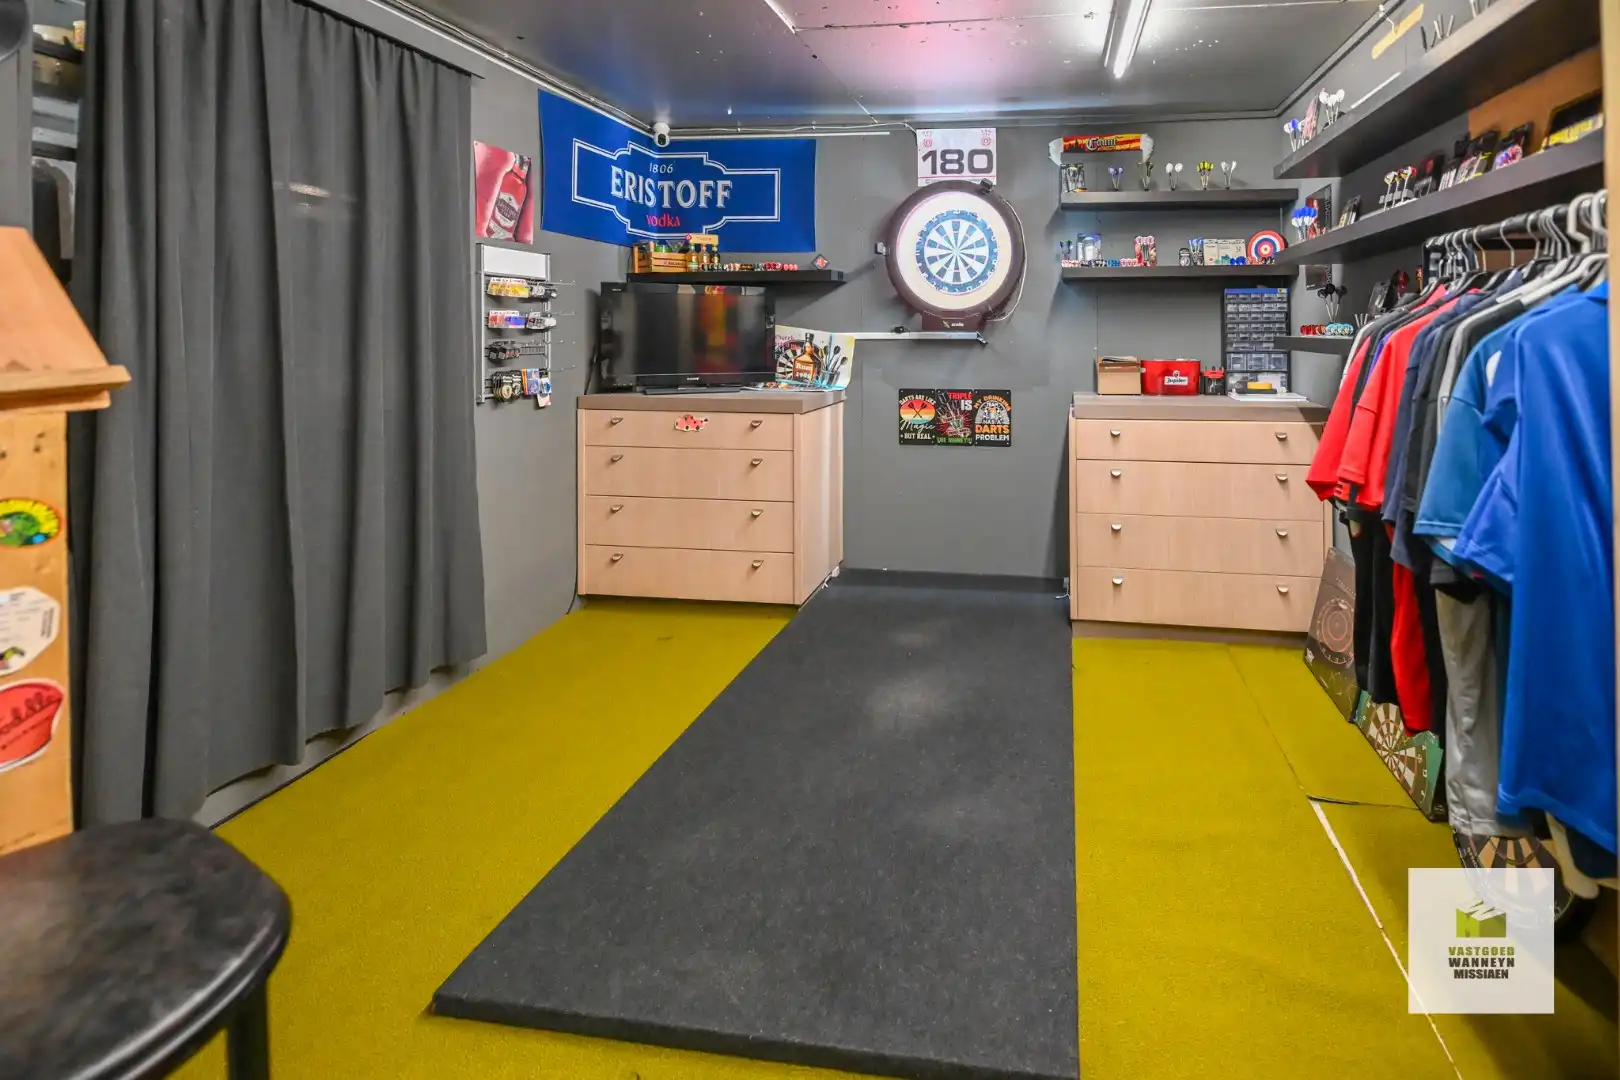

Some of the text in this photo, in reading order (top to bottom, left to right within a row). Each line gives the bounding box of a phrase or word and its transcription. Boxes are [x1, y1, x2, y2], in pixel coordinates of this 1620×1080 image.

[649, 162, 674, 174] 1806
[921, 149, 994, 175] 180
[610, 165, 733, 209] ERISTOFF
[646, 213, 681, 228] vodka
[948, 392, 973, 400] TRIPLE
[960, 400, 973, 411] IS
[899, 419, 936, 434] Magic
[975, 424, 1010, 434] DARTS
[904, 432, 932, 440] BUT REAL
